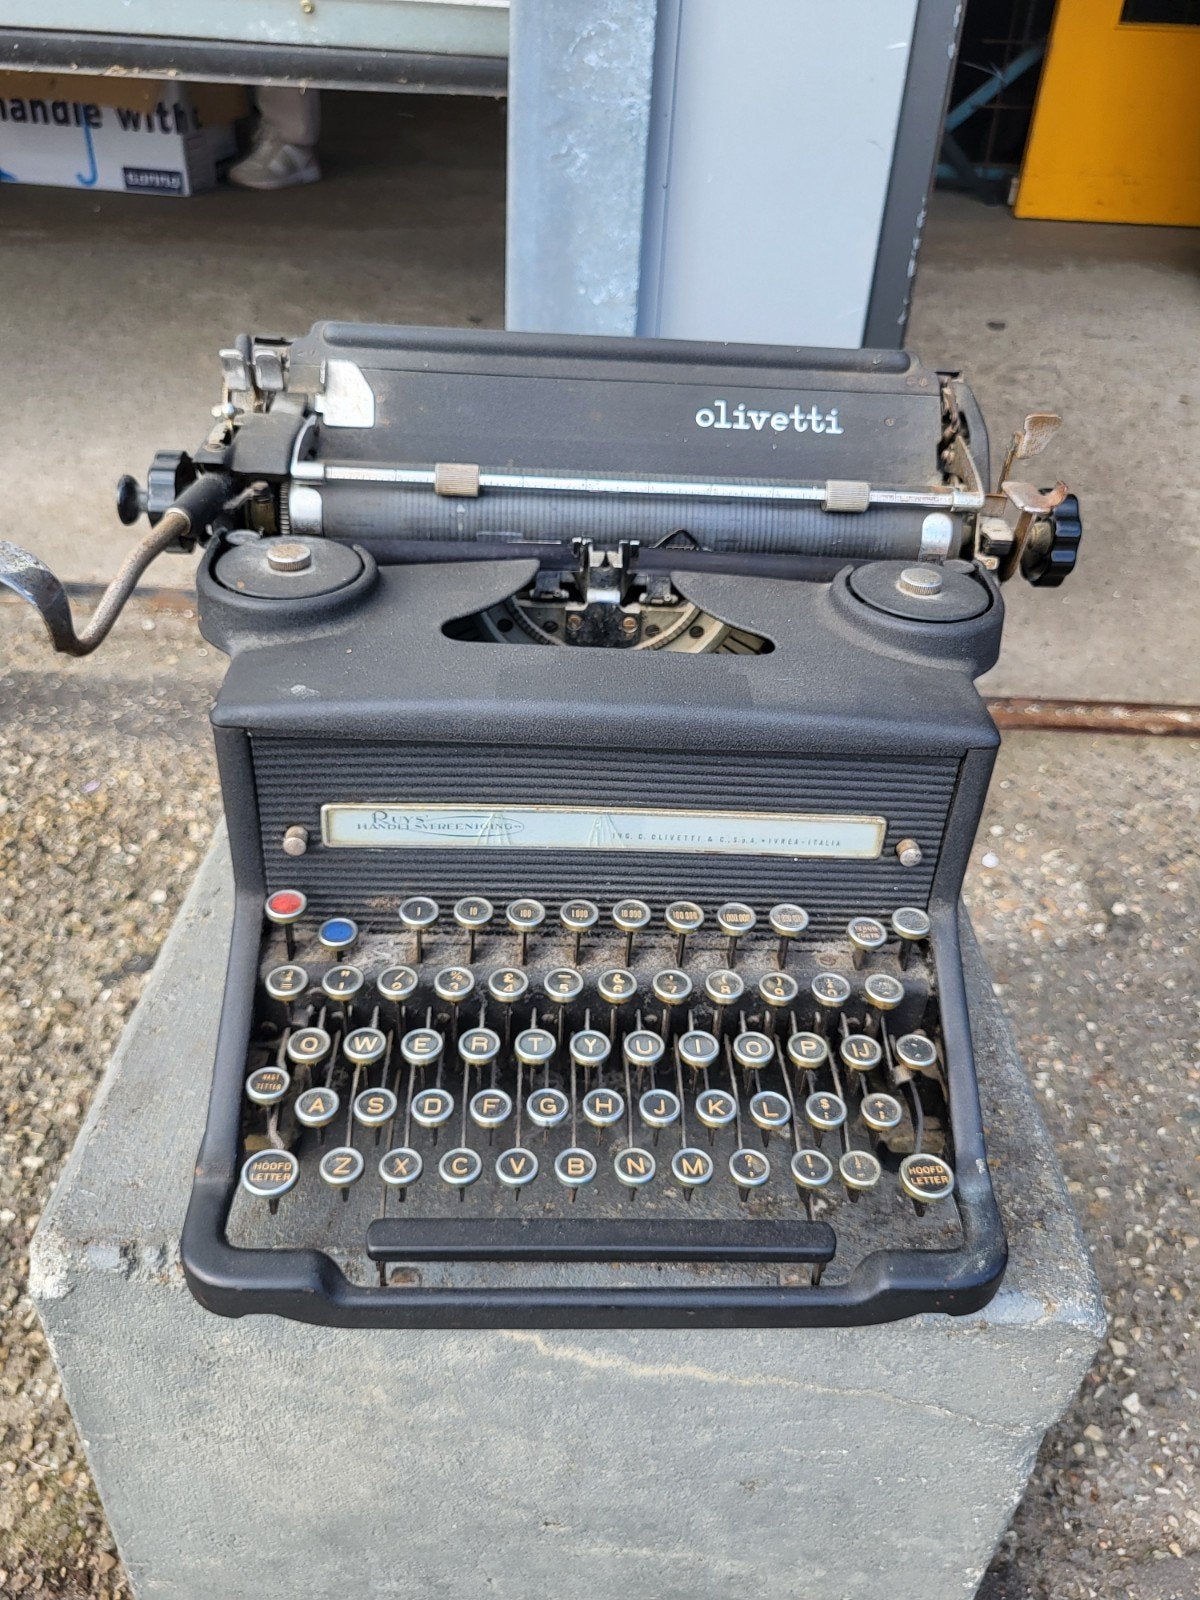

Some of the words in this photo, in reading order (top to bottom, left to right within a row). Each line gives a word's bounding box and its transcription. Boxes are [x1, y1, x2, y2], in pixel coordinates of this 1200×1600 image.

[695, 400, 844, 434] olivetti
[651, 834, 701, 842] OLIVETTI
[469, 906, 478, 916] 10
[355, 1036, 378, 1052] W
[414, 1037, 431, 1052] E
[470, 1036, 488, 1051] R
[527, 1037, 544, 1052] T
[584, 1038, 597, 1053] Y
[635, 1040, 653, 1055] U
[744, 1041, 762, 1055] O
[800, 1040, 816, 1056] P
[307, 1097, 325, 1113] A
[366, 1097, 385, 1114] S
[422, 1097, 442, 1115] D
[483, 1098, 500, 1114] F
[540, 1097, 556, 1114] G
[595, 1097, 612, 1113] H
[653, 1098, 665, 1114] J
[708, 1098, 726, 1115] K
[761, 1101, 779, 1117] L
[254, 1161, 292, 1170] HOOFD
[333, 1157, 352, 1174] Z
[392, 1157, 409, 1175] X
[451, 1157, 468, 1174] C
[509, 1157, 525, 1174] V
[567, 1157, 585, 1174] B
[626, 1157, 645, 1174] N
[682, 1158, 704, 1175] M
[908, 1165, 944, 1175] HOOFD
[250, 1172, 291, 1182] LETTER
[911, 1175, 949, 1184] LETTER
